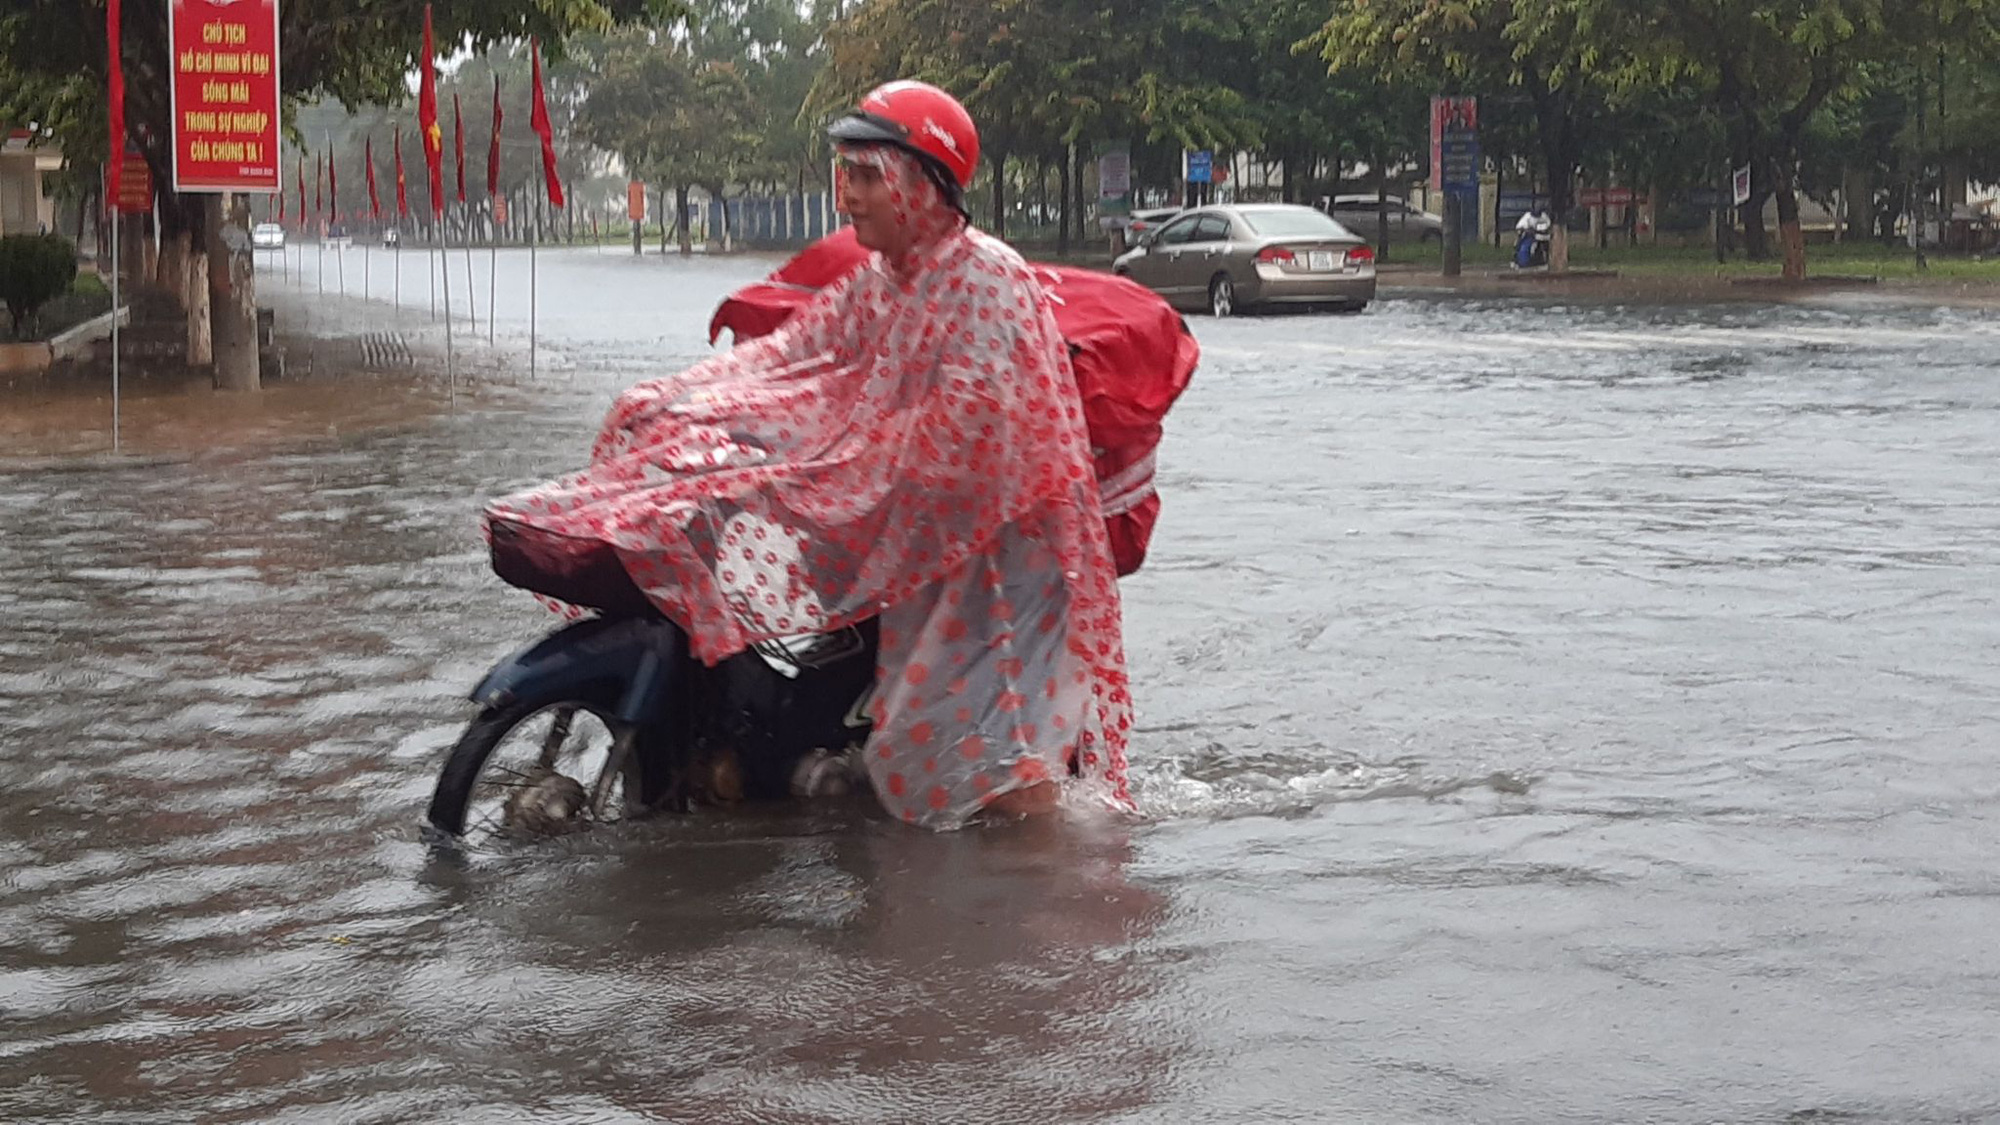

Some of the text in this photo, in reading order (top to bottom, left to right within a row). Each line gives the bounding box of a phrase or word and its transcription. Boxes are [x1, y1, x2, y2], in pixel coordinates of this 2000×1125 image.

[203, 17, 246, 48] CHỦ TỊCH
[196, 49, 212, 73] CHÍ
[214, 53, 240, 73] MINH
[185, 109, 268, 137] TRONG SỰ NGHIỆP
[190, 135, 210, 162] CỦA
[212, 138, 244, 163] CHÚNG
[246, 141, 257, 163] TA
